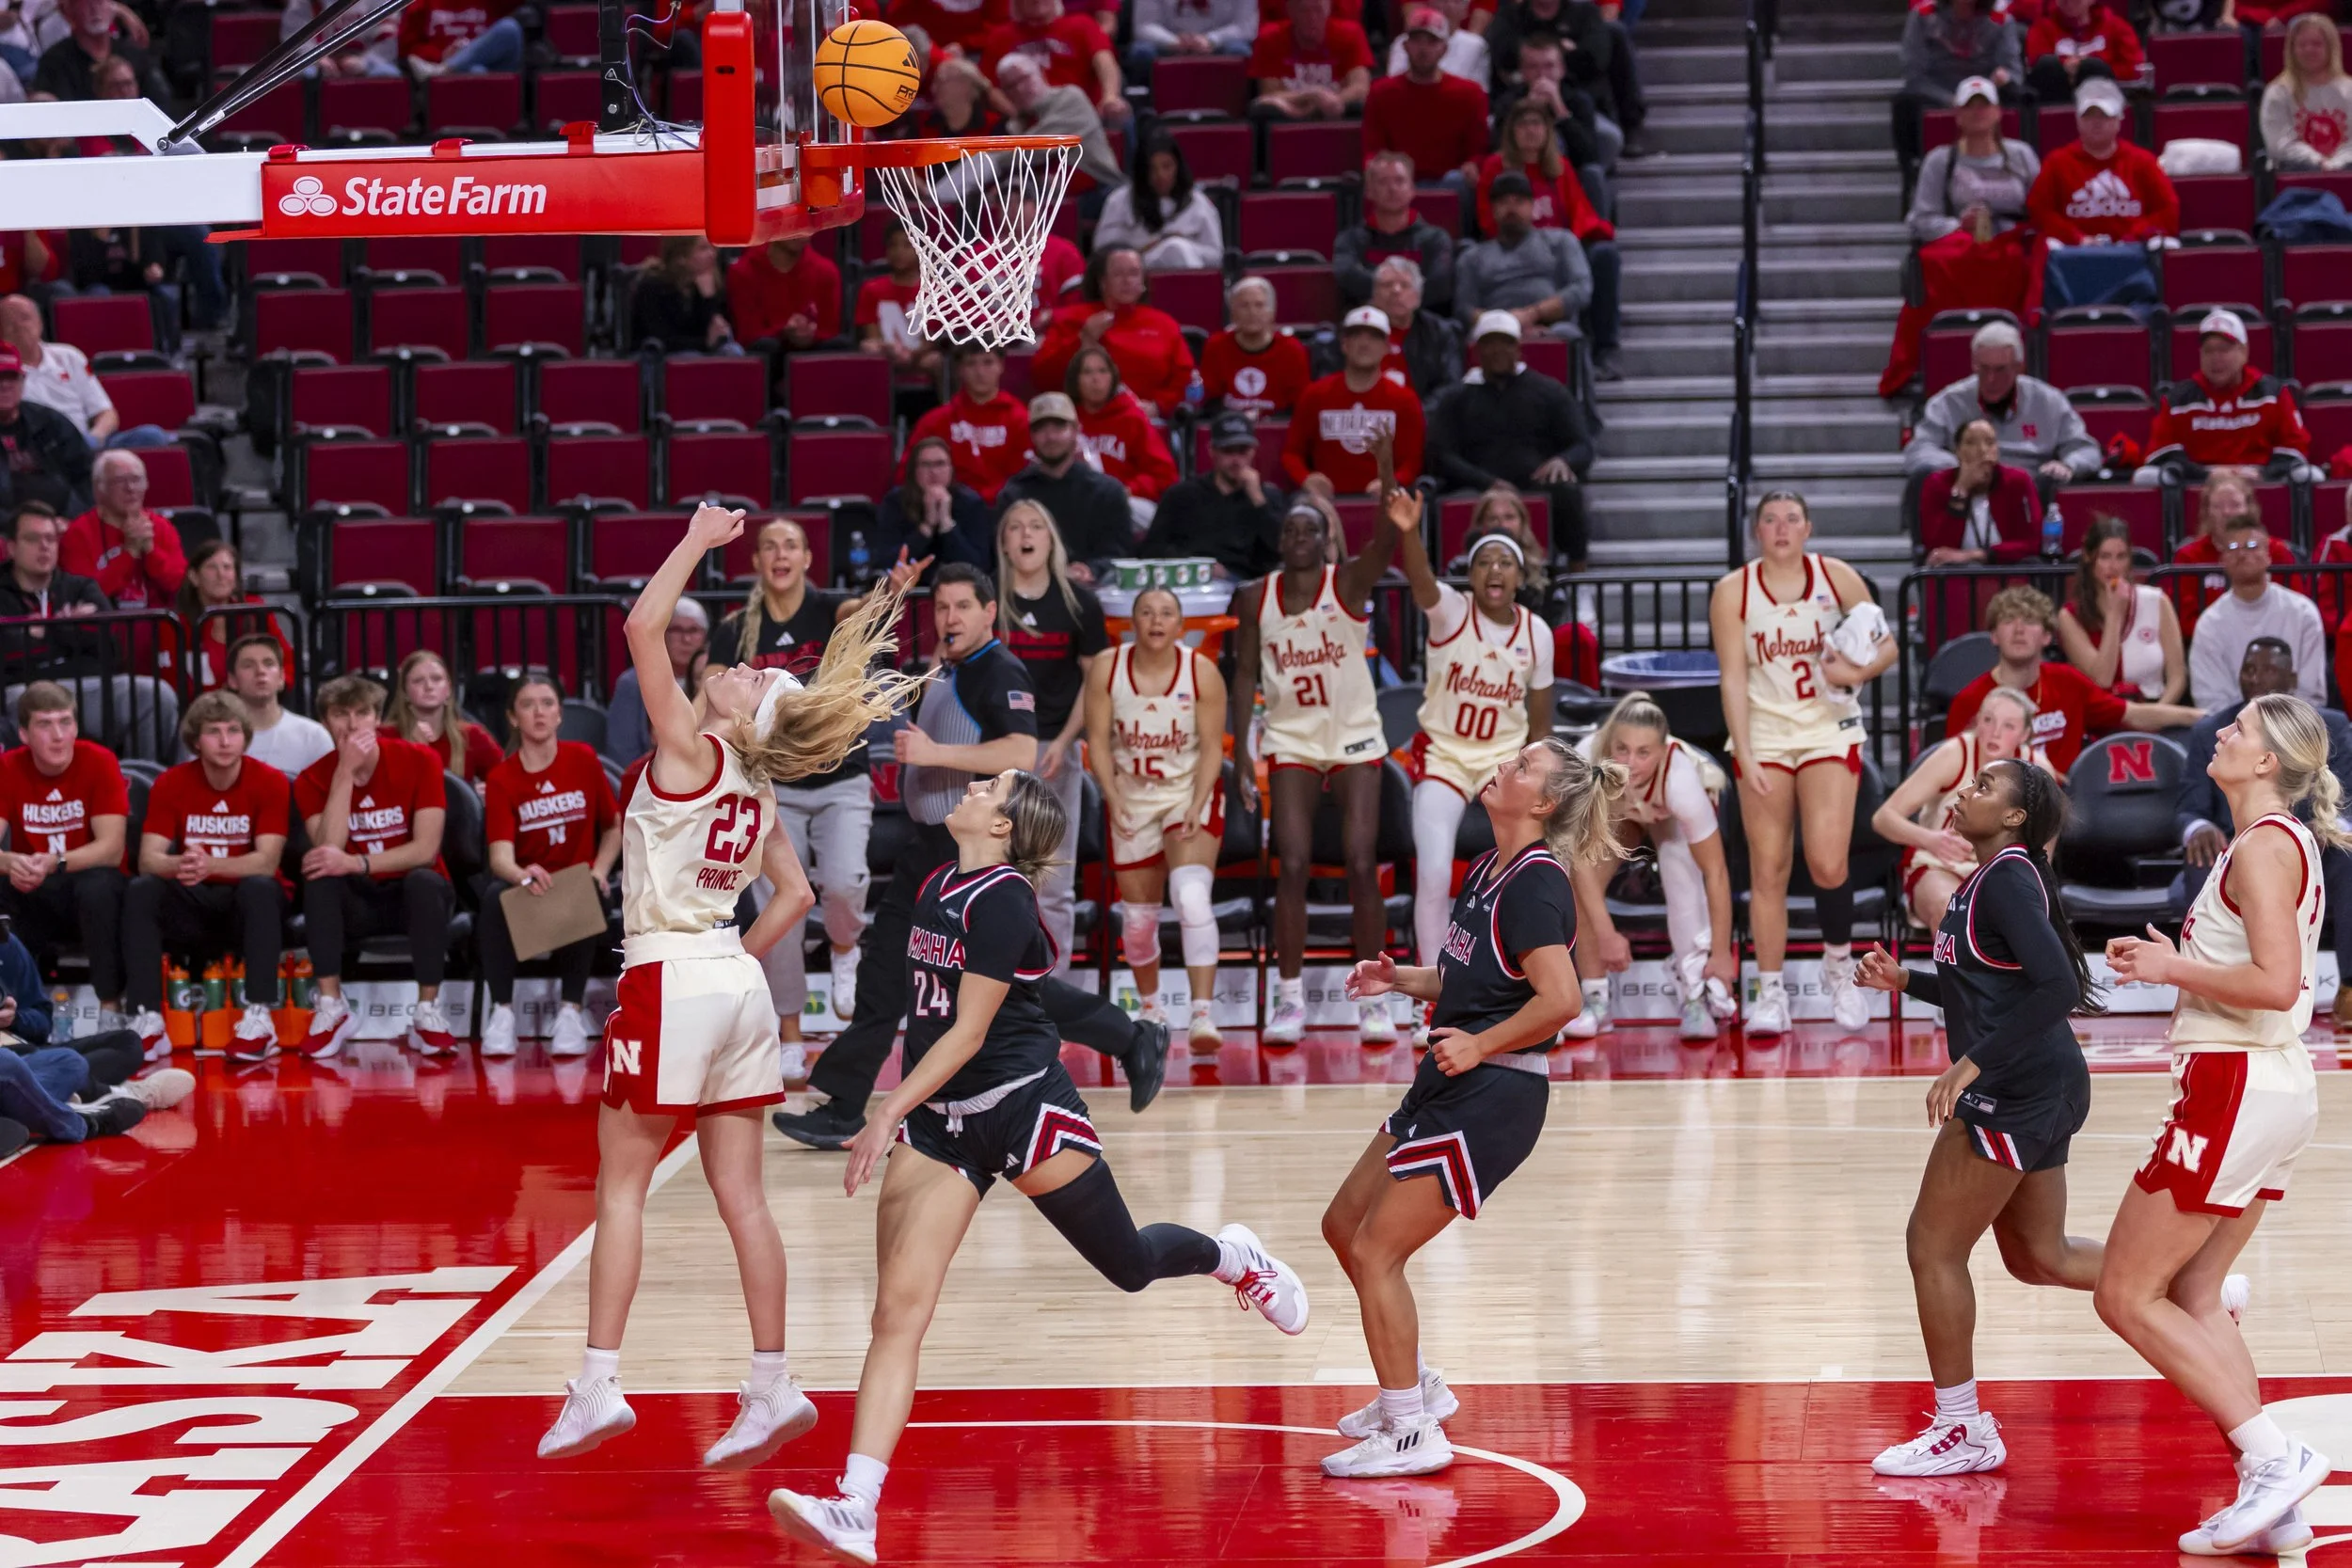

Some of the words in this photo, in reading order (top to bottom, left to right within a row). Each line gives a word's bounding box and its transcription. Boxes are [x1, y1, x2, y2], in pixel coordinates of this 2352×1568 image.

[1267, 631, 1347, 674] Nebraska
[1751, 620, 1826, 666] Nebrask
[1293, 673, 1328, 707] 21
[1446, 662, 1524, 708] Nebraska
[1791, 660, 1816, 700] 2
[1454, 703, 1499, 740] 00
[1133, 756, 1165, 780] 15
[2107, 741, 2155, 784] N
[347, 806, 405, 831] USKERS
[519, 790, 586, 821] HUSKERS
[705, 793, 761, 863] 23
[696, 867, 743, 891] PRINCE
[914, 970, 950, 1017] 24
[612, 1037, 643, 1076] N
[2166, 1126, 2210, 1174] N
